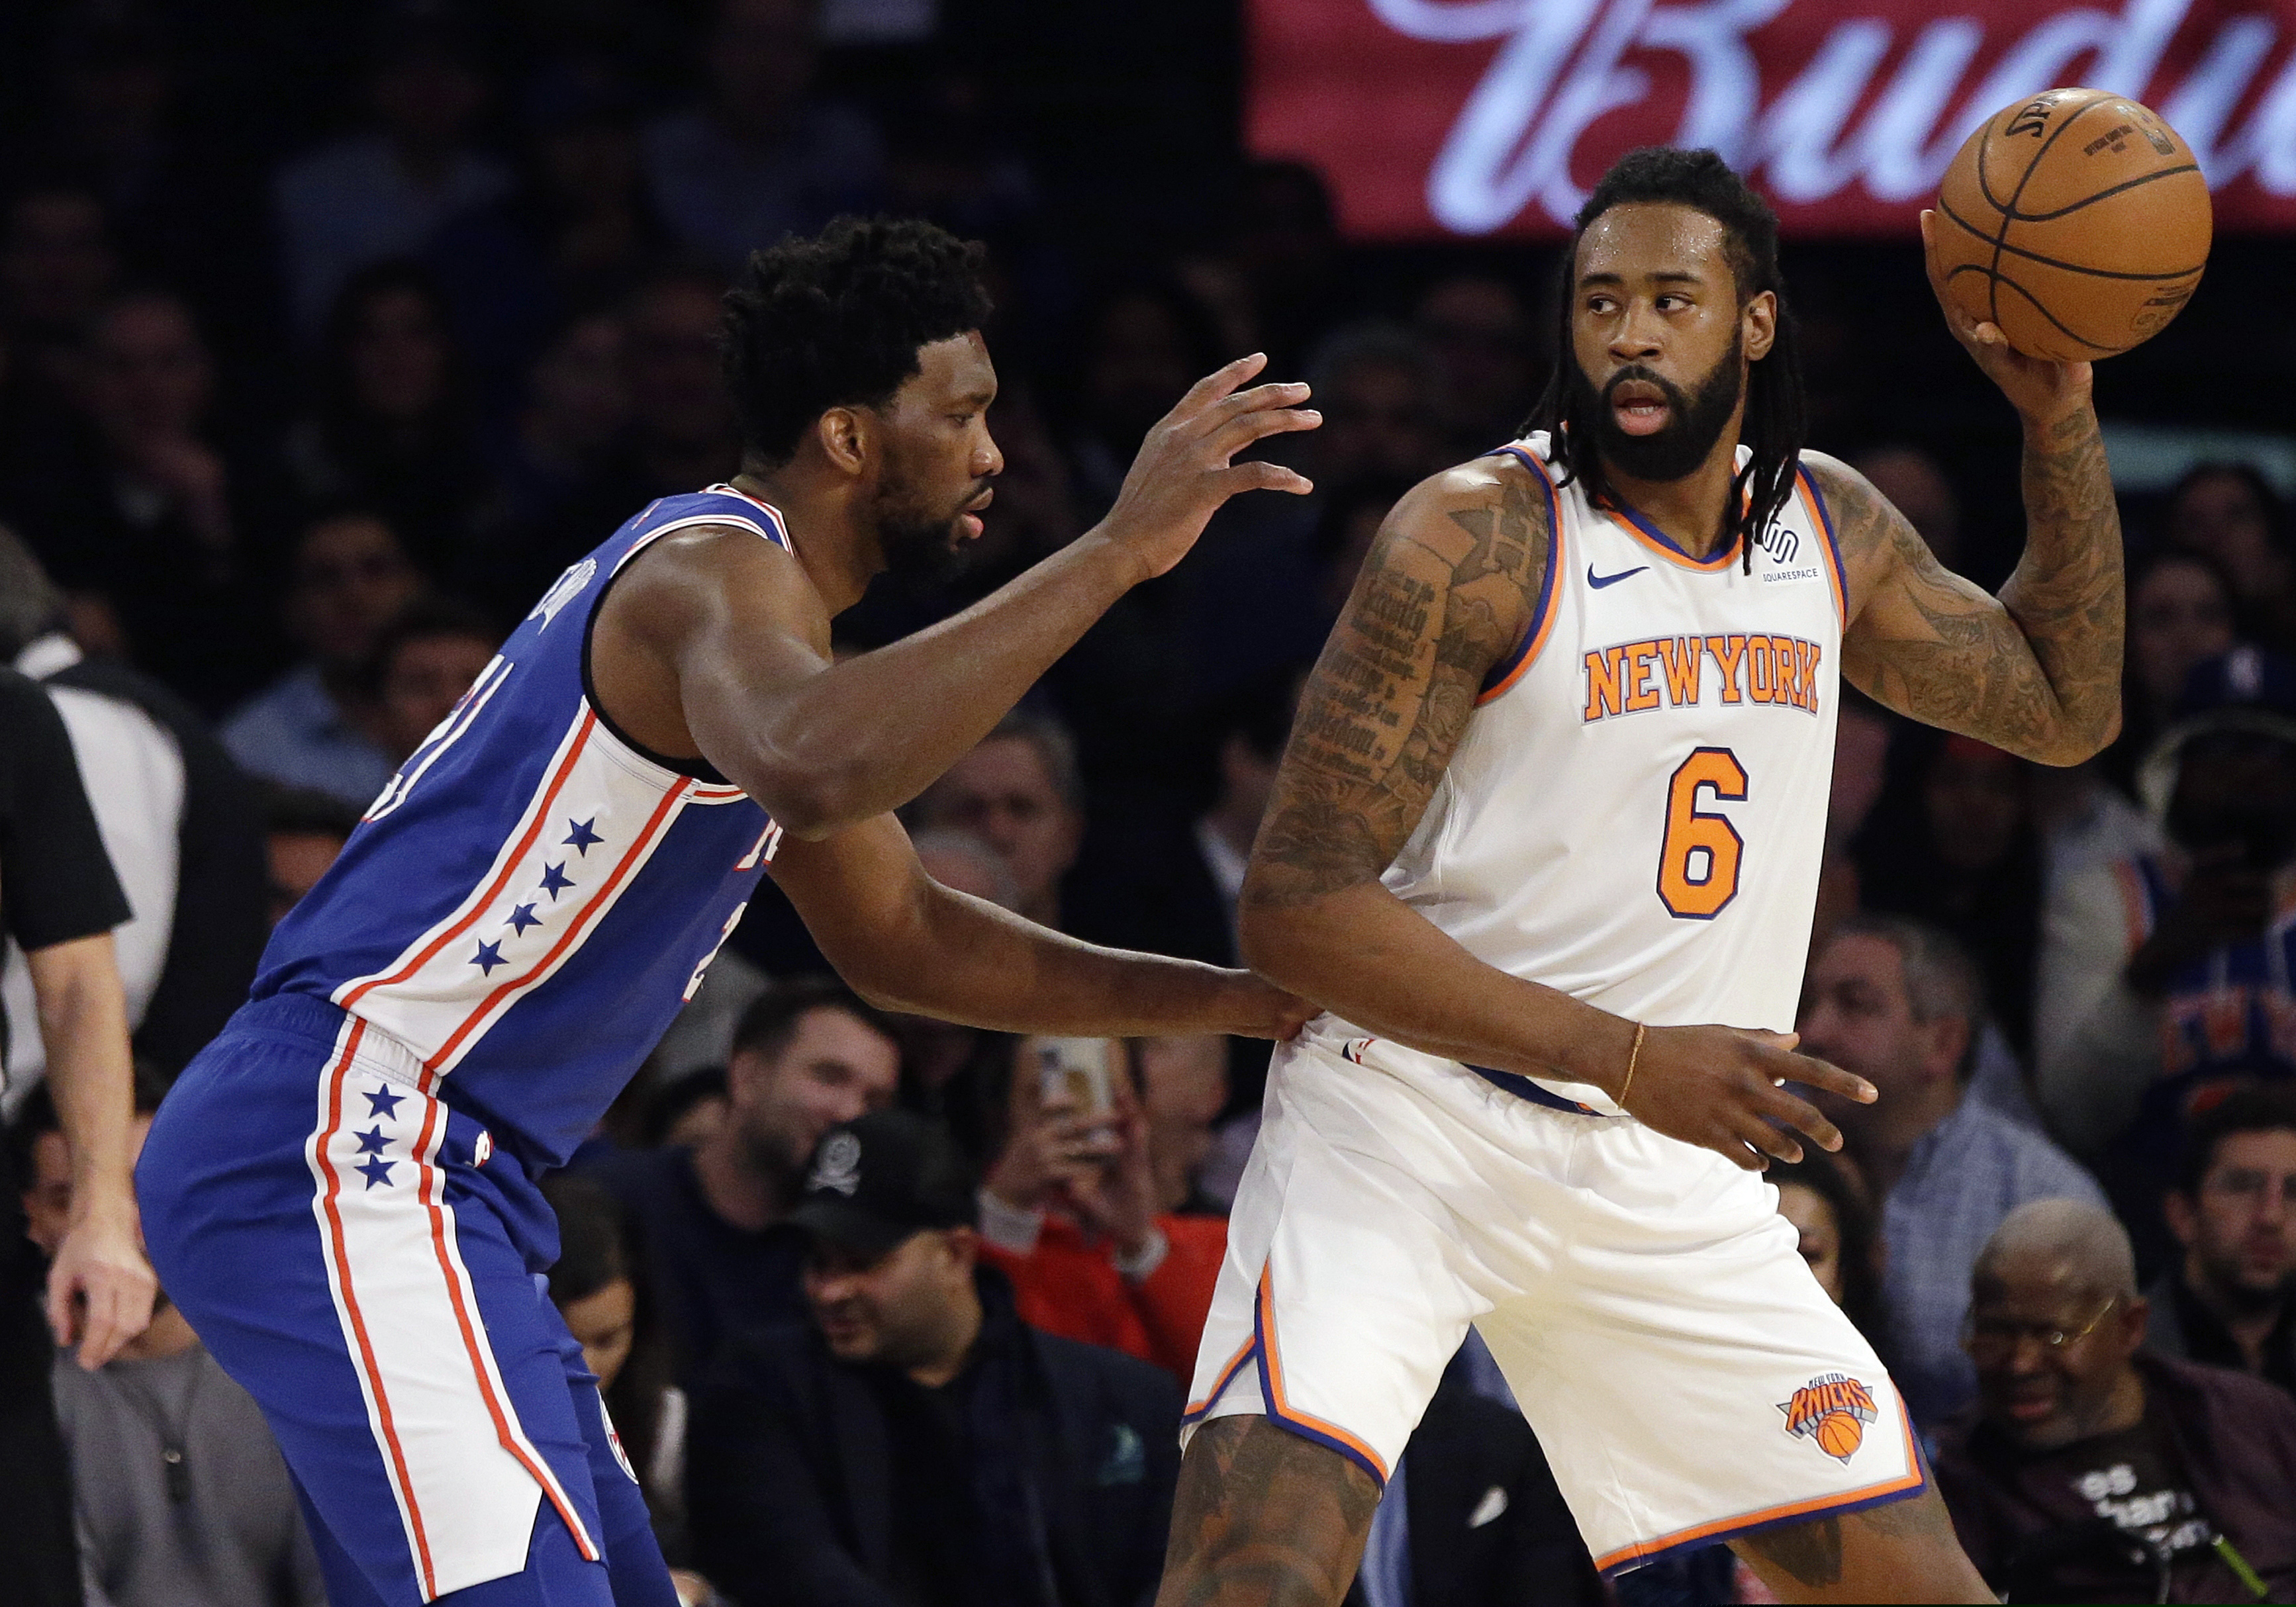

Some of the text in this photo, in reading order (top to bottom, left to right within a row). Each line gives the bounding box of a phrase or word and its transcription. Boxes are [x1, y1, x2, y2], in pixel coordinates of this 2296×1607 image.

[1762, 568, 1819, 582] SQUARESPACE
[1582, 632, 1822, 726] NEW YORK
[1656, 747, 1748, 920] 6
[1786, 1377, 1879, 1434] KNICKS
[1808, 1372, 1847, 1389] NEW YORK
